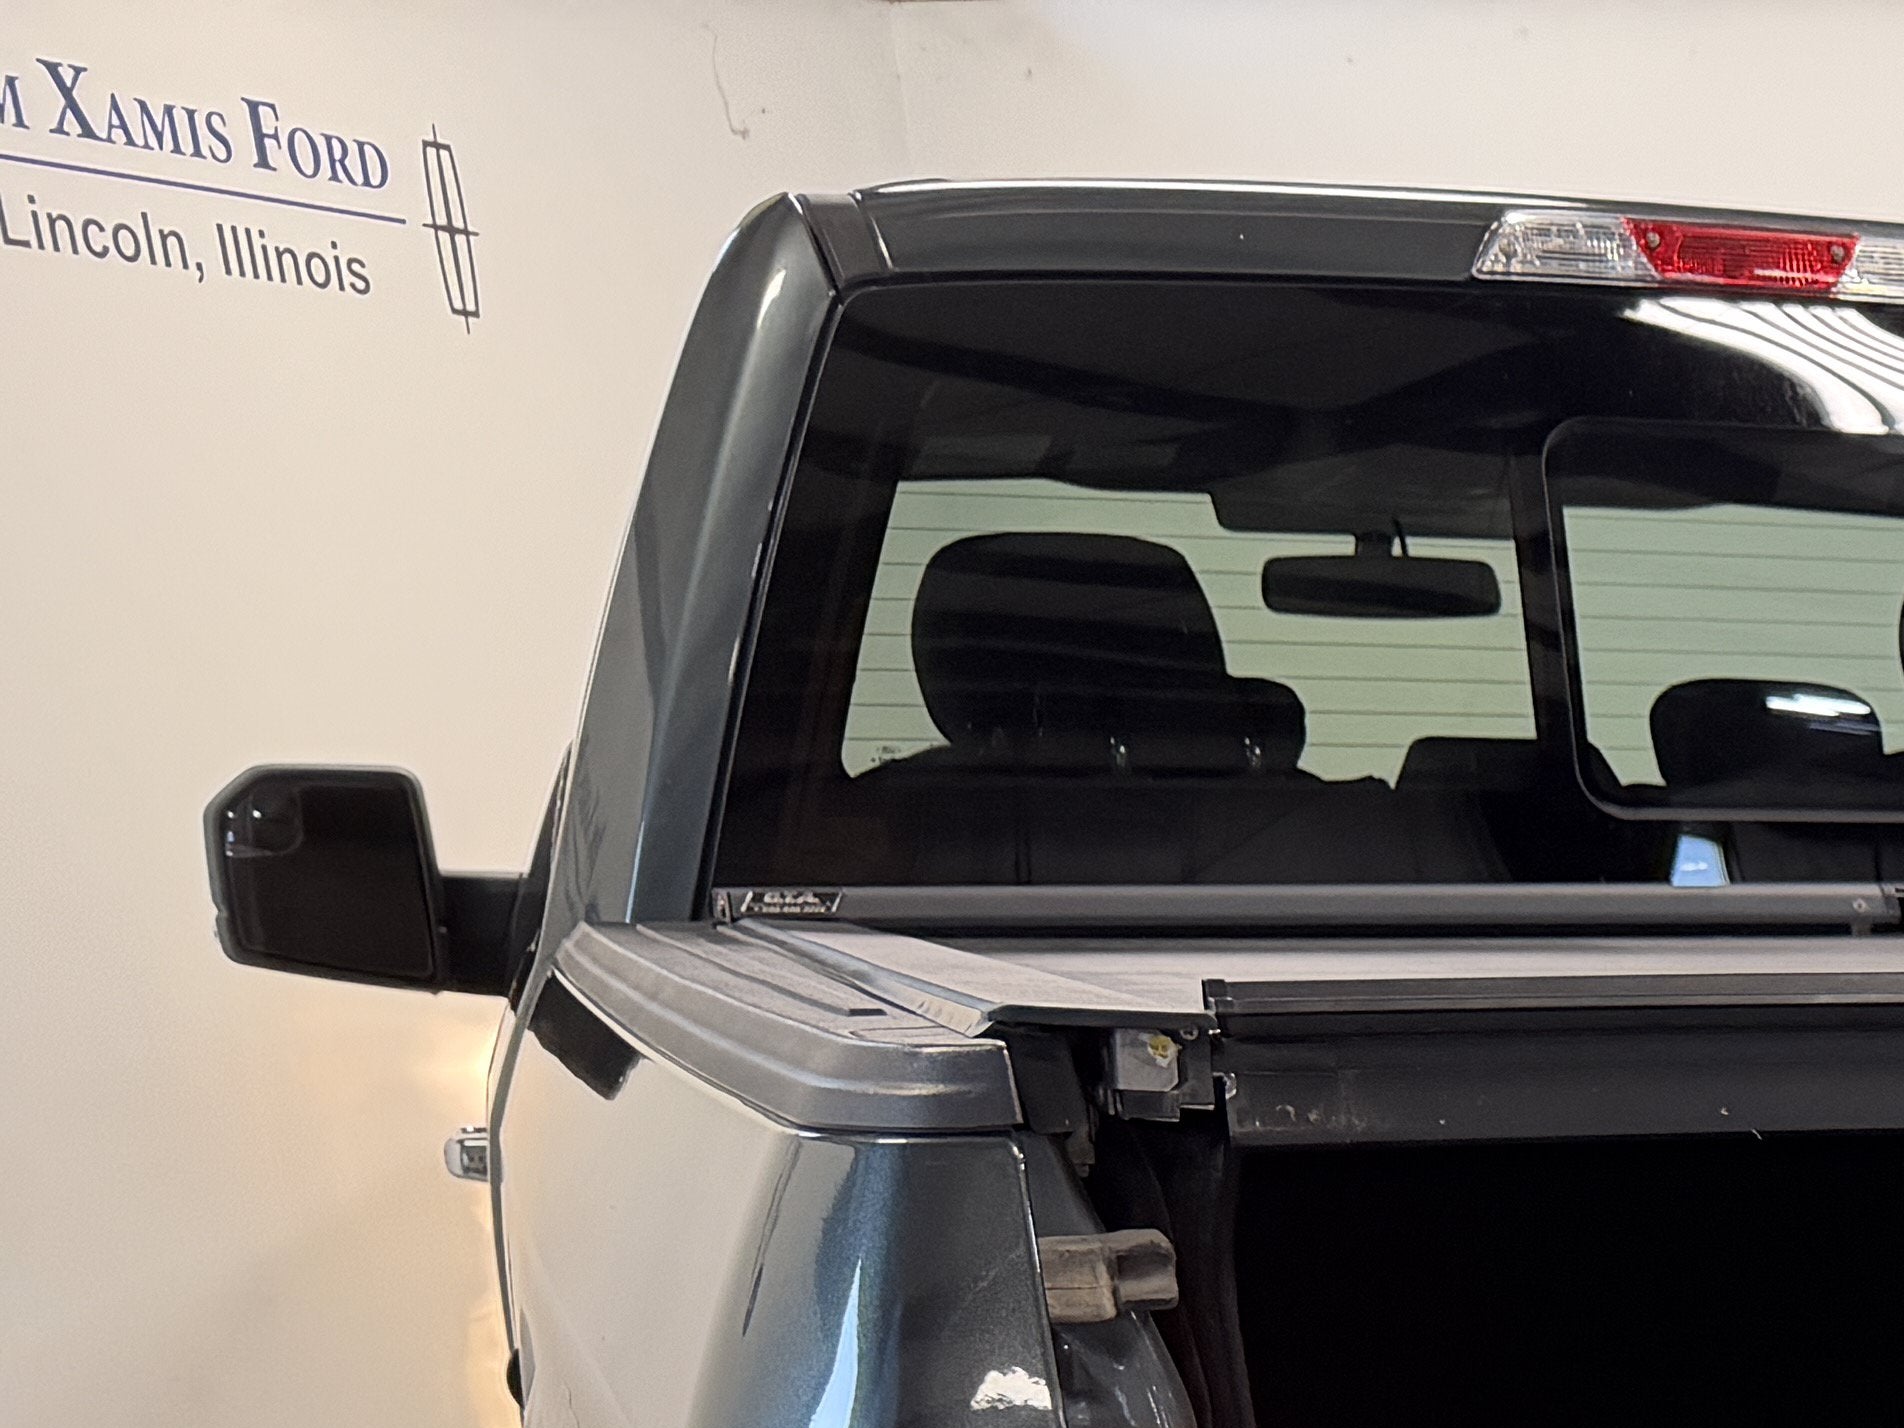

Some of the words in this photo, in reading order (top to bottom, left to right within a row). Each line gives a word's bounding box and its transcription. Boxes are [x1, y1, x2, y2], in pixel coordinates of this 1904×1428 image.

[35, 57, 233, 164] XAMIS
[240, 96, 389, 189] FORD
[0, 191, 205, 284] Lincoln,
[215, 222, 371, 296] Illinois
